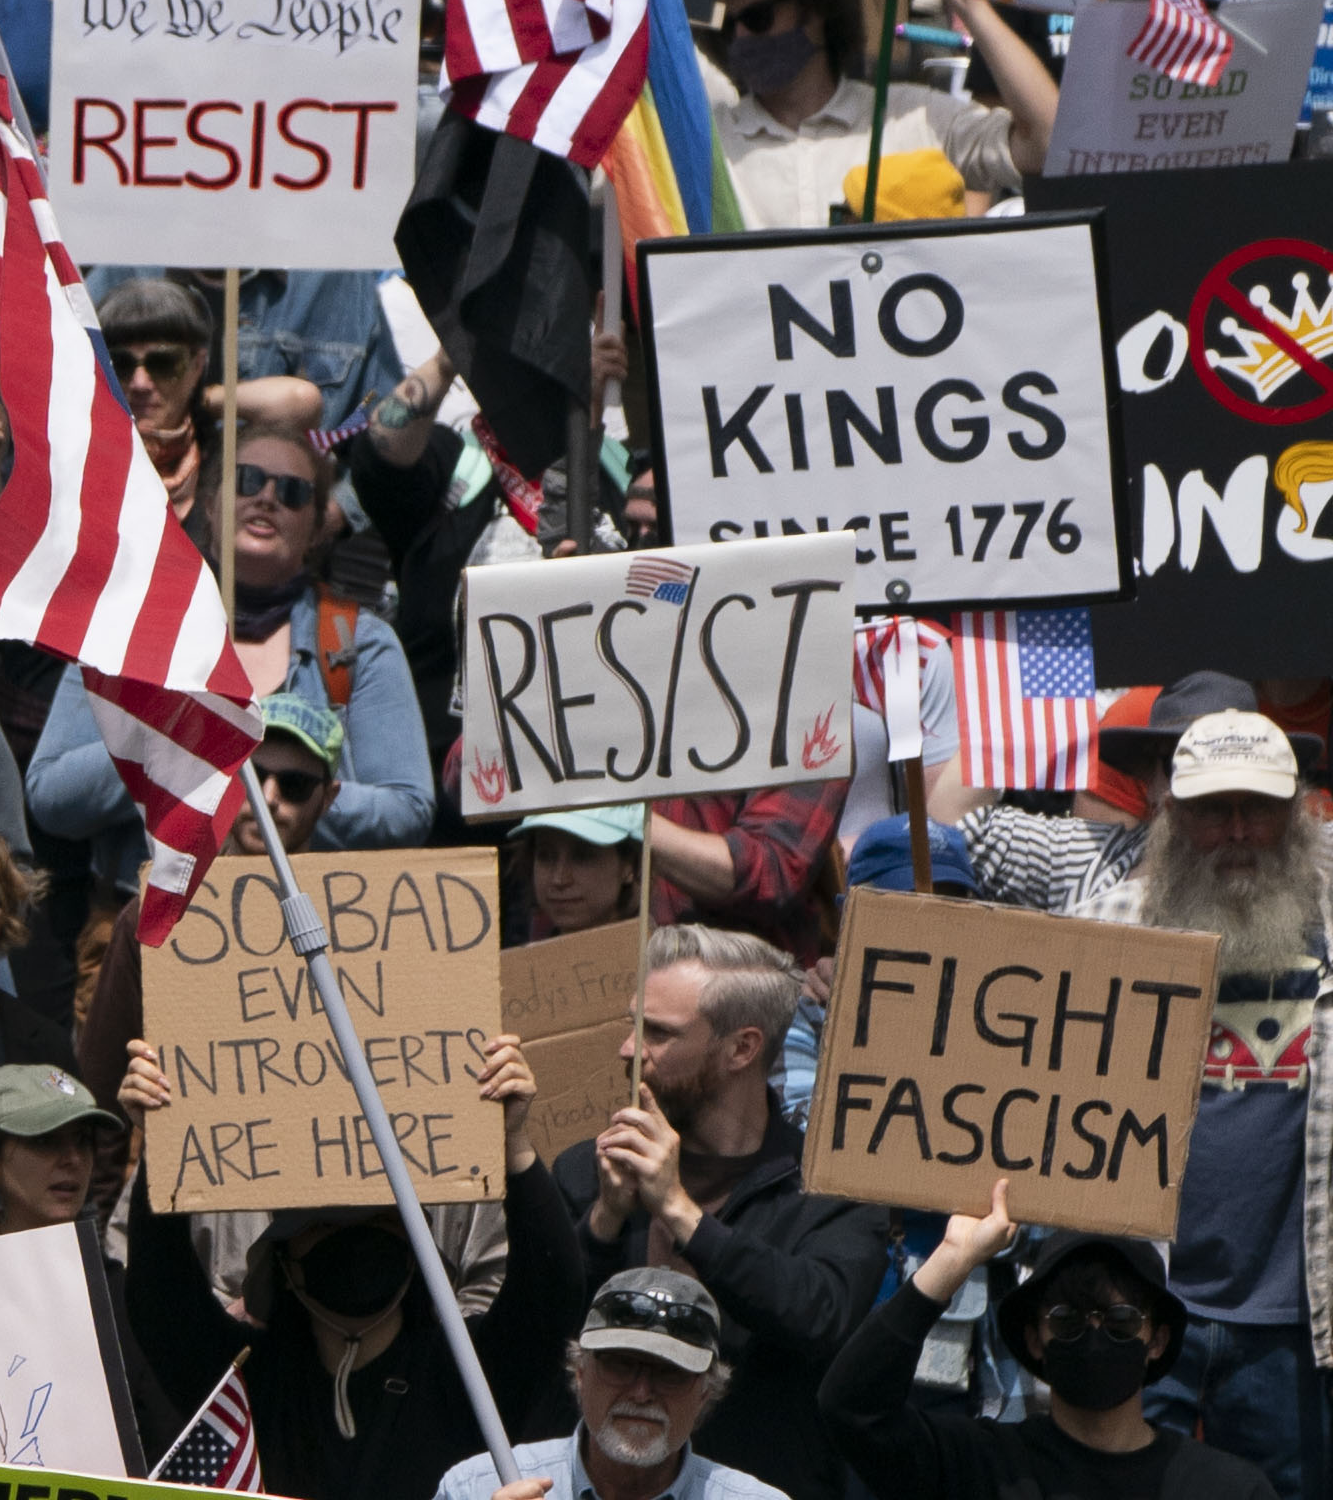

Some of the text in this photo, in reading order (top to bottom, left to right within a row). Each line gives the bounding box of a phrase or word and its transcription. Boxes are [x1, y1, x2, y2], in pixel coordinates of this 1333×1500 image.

[71, 97, 400, 192] RESIST
[1133, 109, 1228, 142] EVEN
[766, 272, 965, 362] NO
[700, 369, 1068, 479] KINGS
[475, 565, 845, 792] RESIST
[236, 959, 385, 1022] EVEN
[851, 946, 1202, 1081] FIGHT
[831, 1073, 1170, 1190] FASCISM
